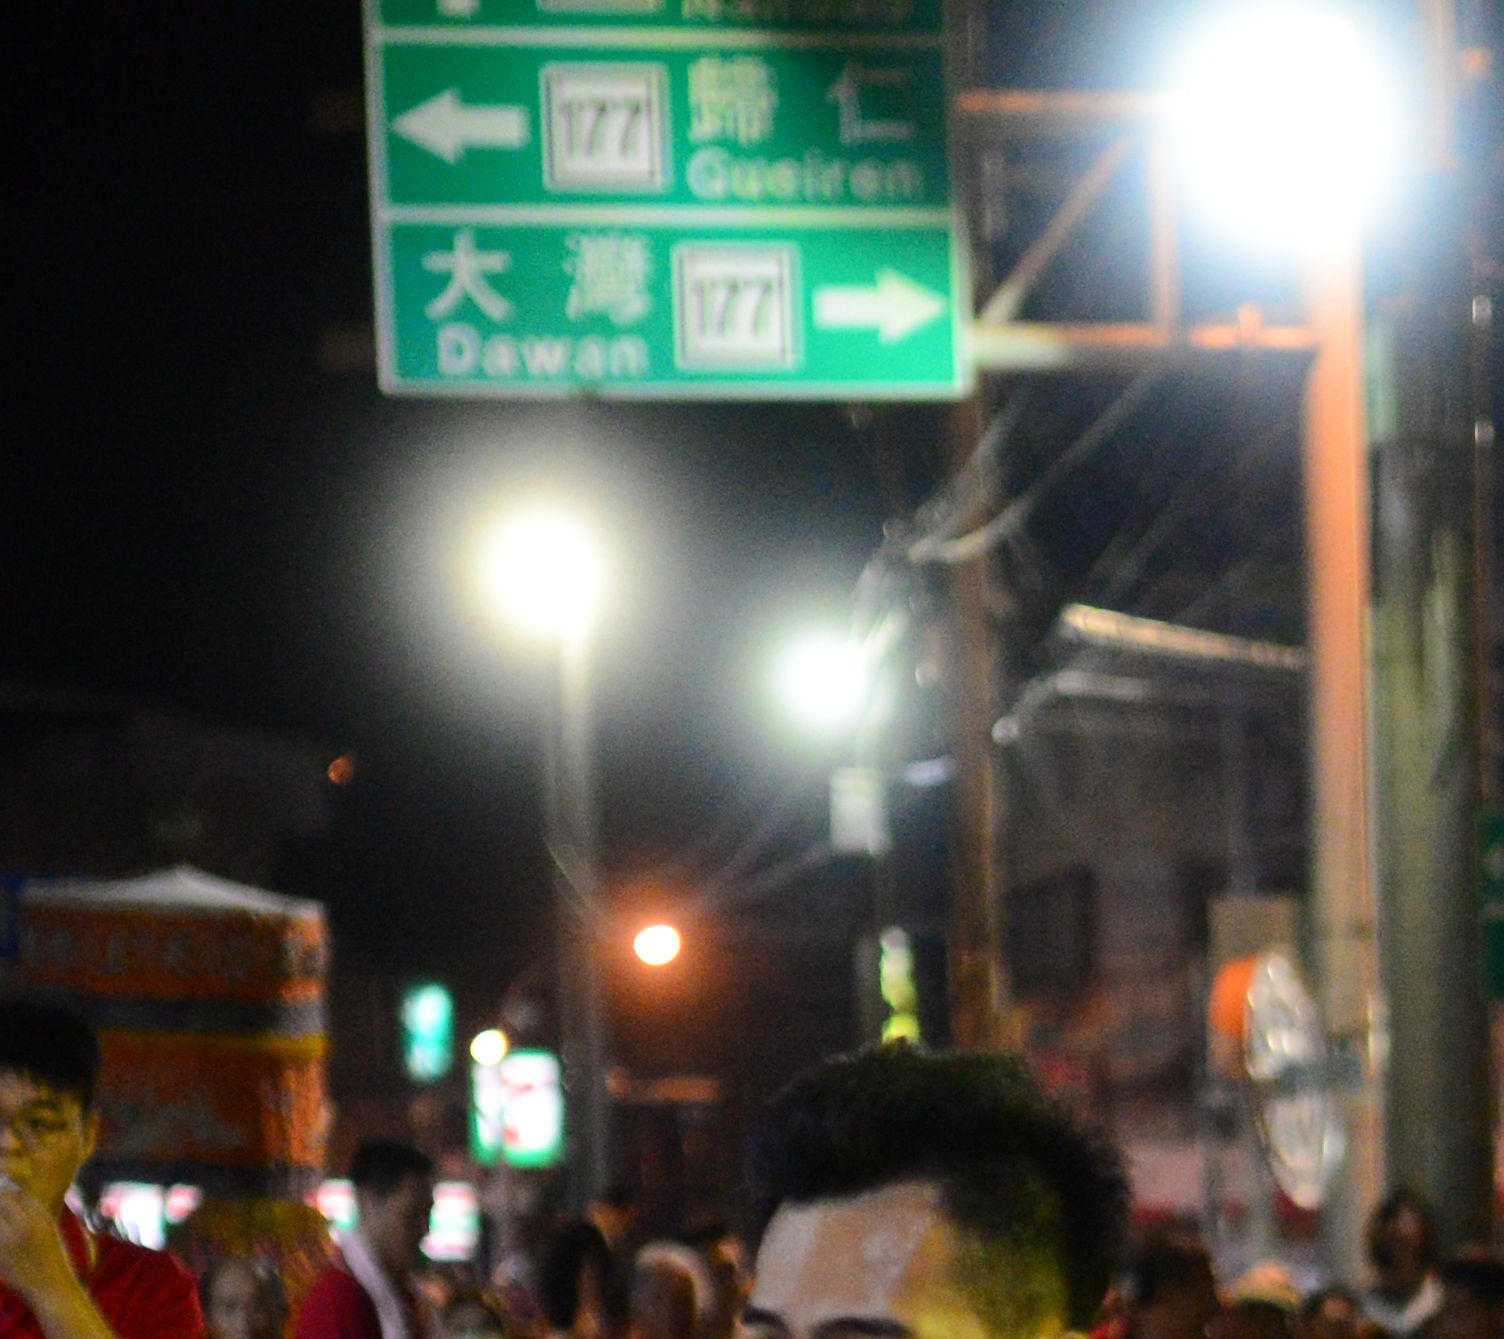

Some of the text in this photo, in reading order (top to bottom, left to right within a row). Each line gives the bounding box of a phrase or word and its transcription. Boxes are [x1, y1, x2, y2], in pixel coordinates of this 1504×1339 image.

[560, 100, 644, 150] 177
[686, 55, 913, 145] 歸仁
[686, 147, 923, 201] Gueiren
[422, 230, 654, 324] 大灣
[694, 278, 775, 336] 177
[436, 323, 651, 377] Dawan
